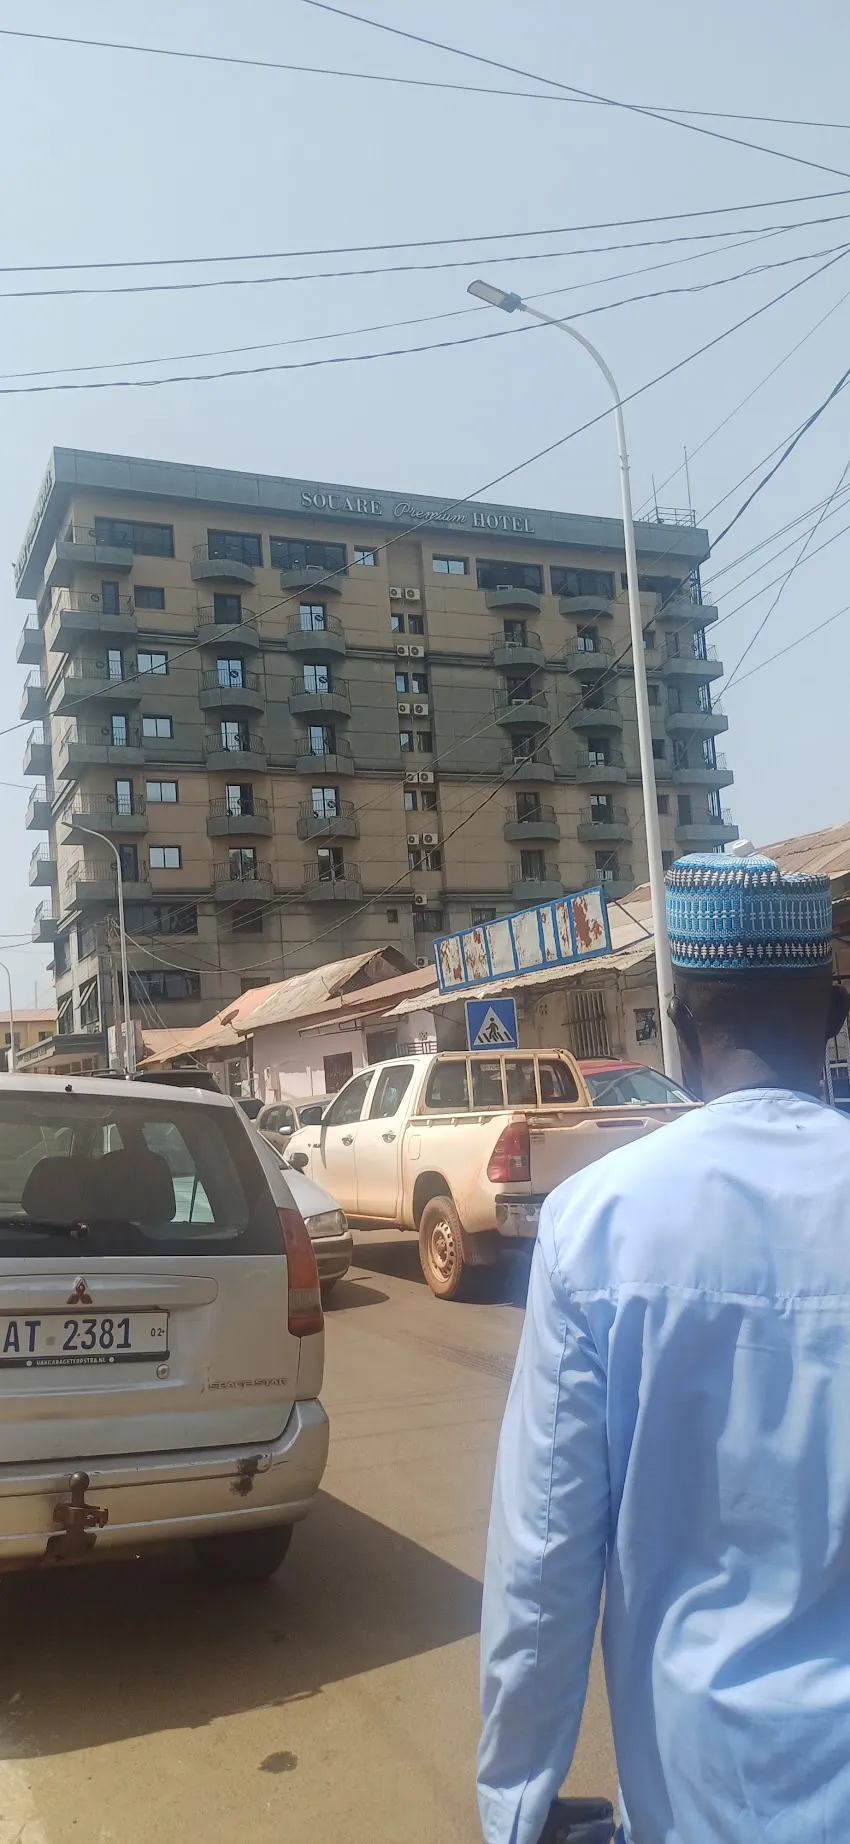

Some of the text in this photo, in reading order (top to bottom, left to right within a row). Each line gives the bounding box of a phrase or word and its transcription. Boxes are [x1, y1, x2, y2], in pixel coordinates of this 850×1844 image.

[393, 502, 467, 524] Premium
[472, 512, 535, 533] HOTEL
[3, 1320, 42, 1352] AT
[62, 1318, 132, 1351] 2381
